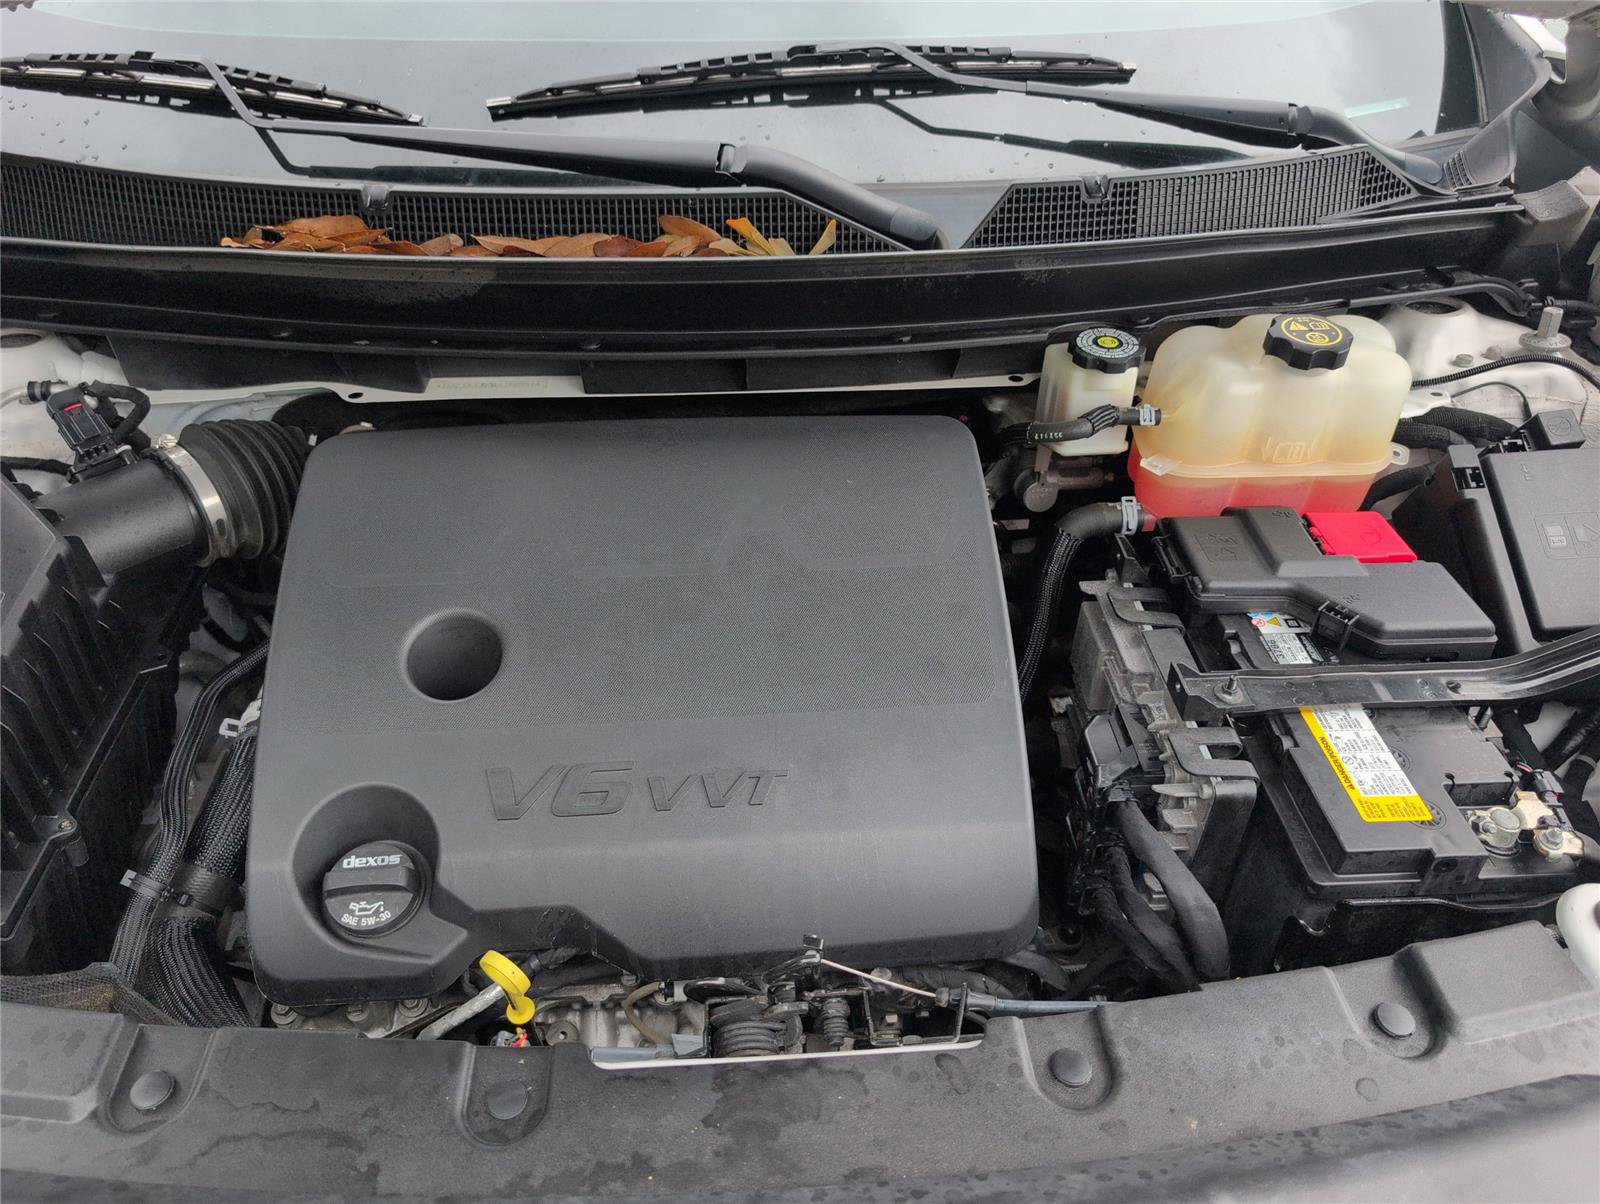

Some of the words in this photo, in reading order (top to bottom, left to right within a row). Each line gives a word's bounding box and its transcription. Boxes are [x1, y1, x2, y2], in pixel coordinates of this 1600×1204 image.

[485, 760, 635, 820] V6
[647, 769, 789, 811] VVT
[342, 854, 403, 868] dexos
[341, 913, 359, 926] SAE
[360, 910, 391, 926] 5W-30
